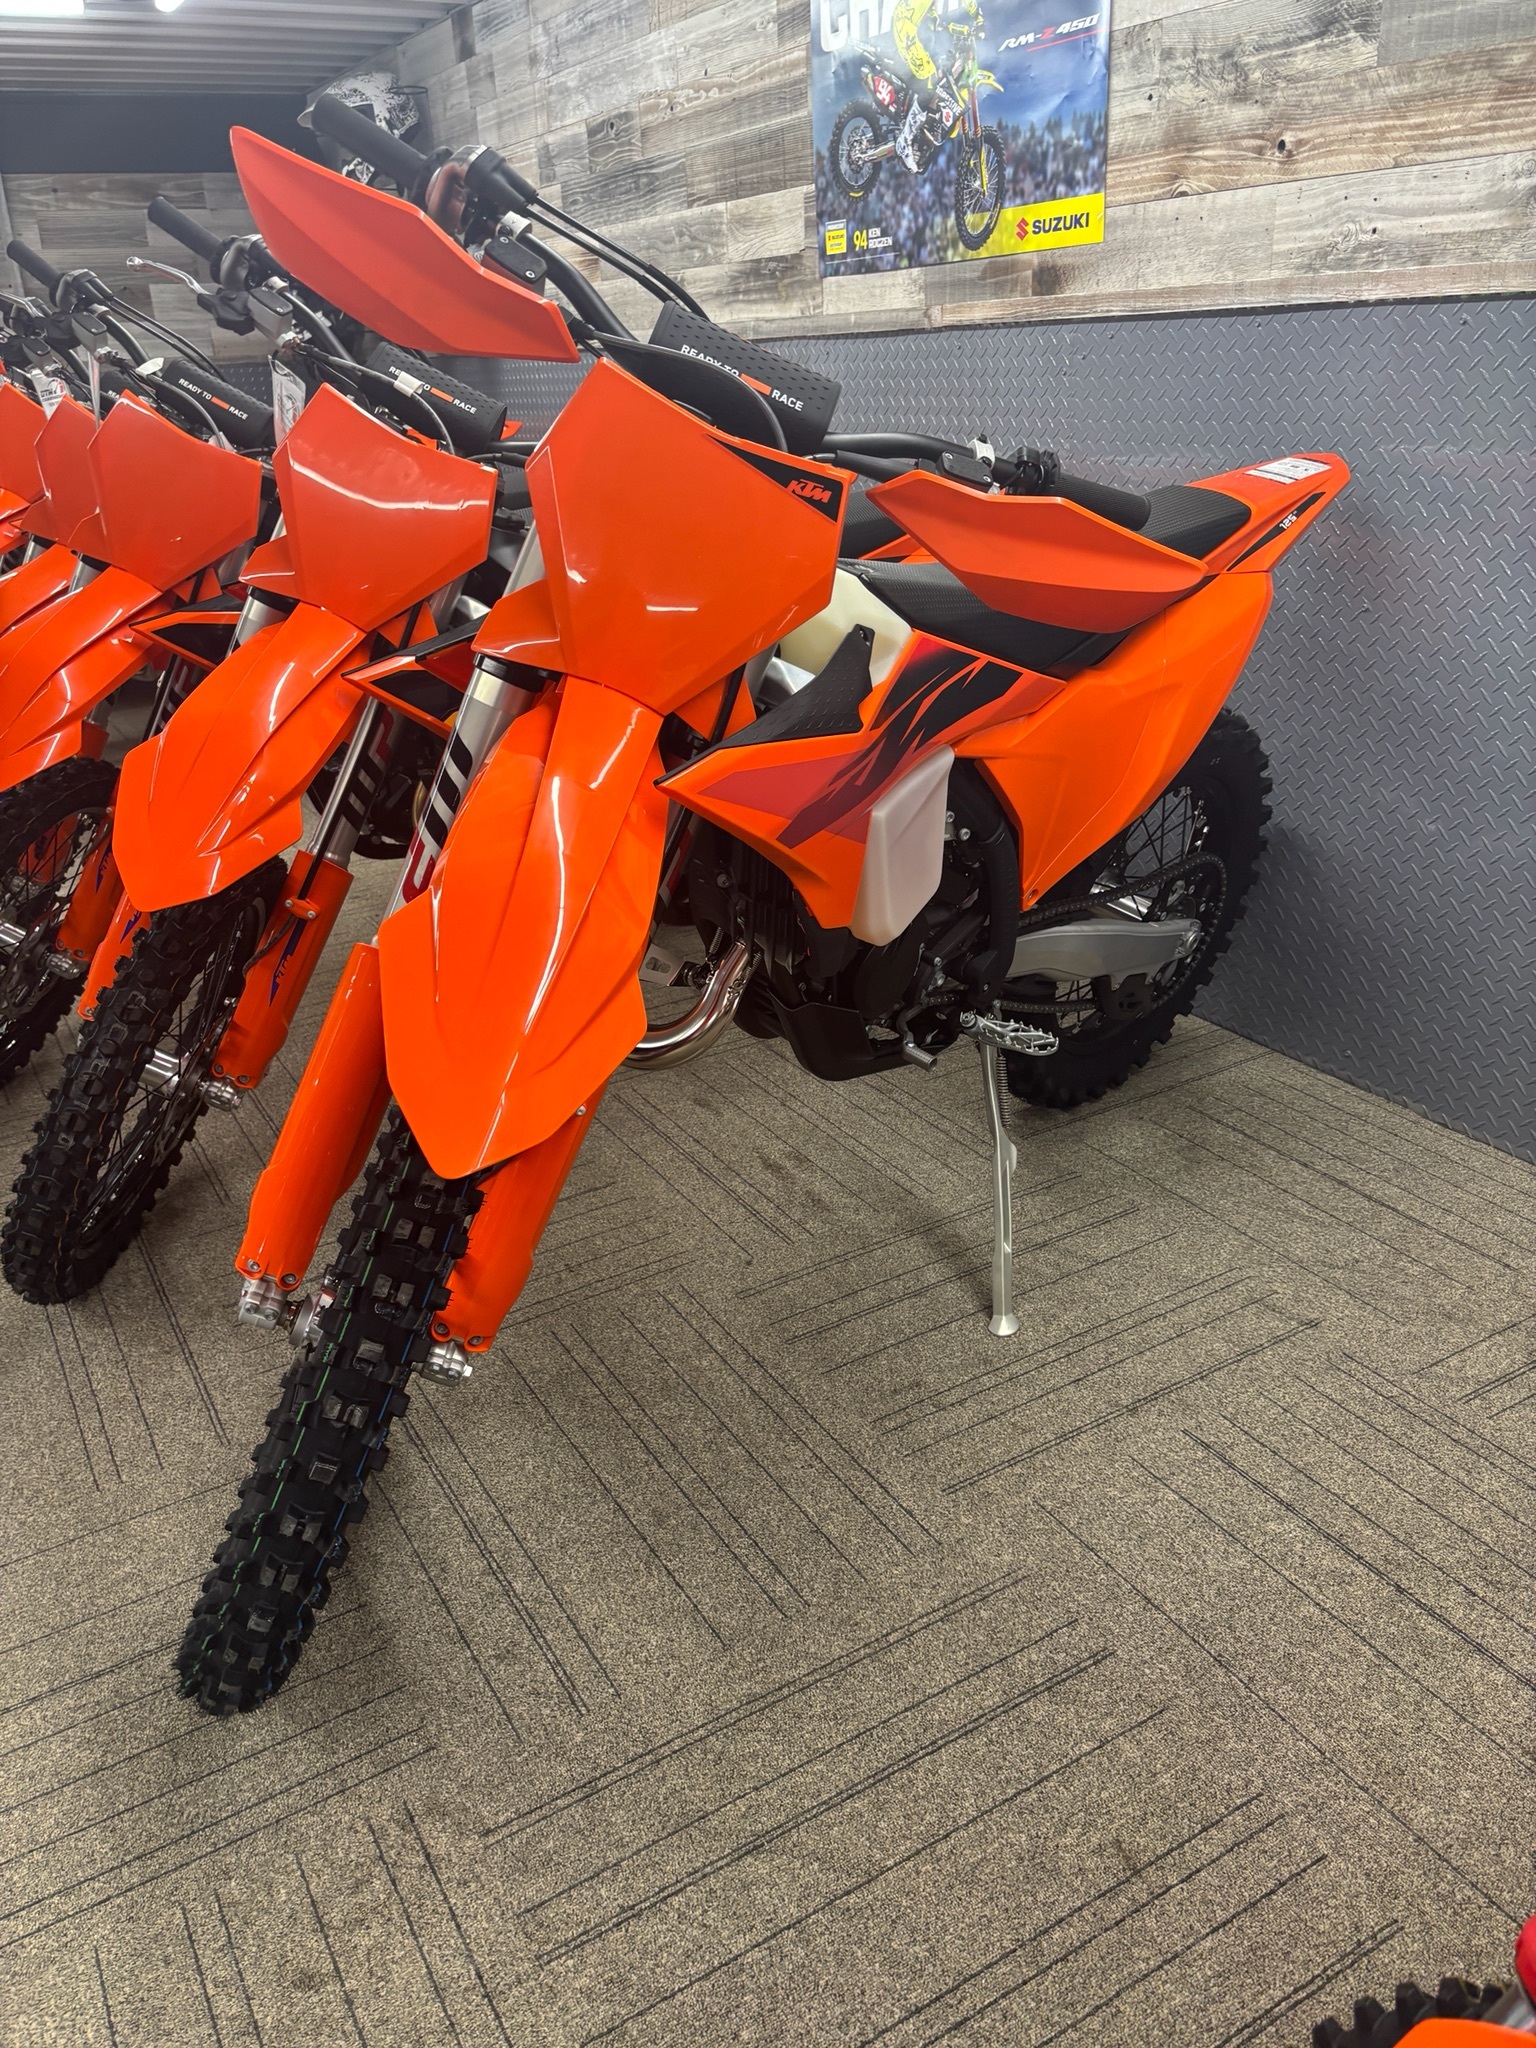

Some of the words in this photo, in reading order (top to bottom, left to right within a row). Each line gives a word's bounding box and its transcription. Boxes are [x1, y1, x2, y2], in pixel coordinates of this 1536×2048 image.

[868, 228, 881, 238] KEN
[1032, 212, 1090, 235] SUZUKI
[853, 229, 867, 251] 94
[178, 378, 202, 395] READY
[202, 391, 212, 401] TO
[228, 405, 249, 420] RACE
[453, 398, 477, 414] RACE
[772, 389, 804, 411] RACE
[786, 479, 832, 503] KTM
[1279, 513, 1297, 529] 125
